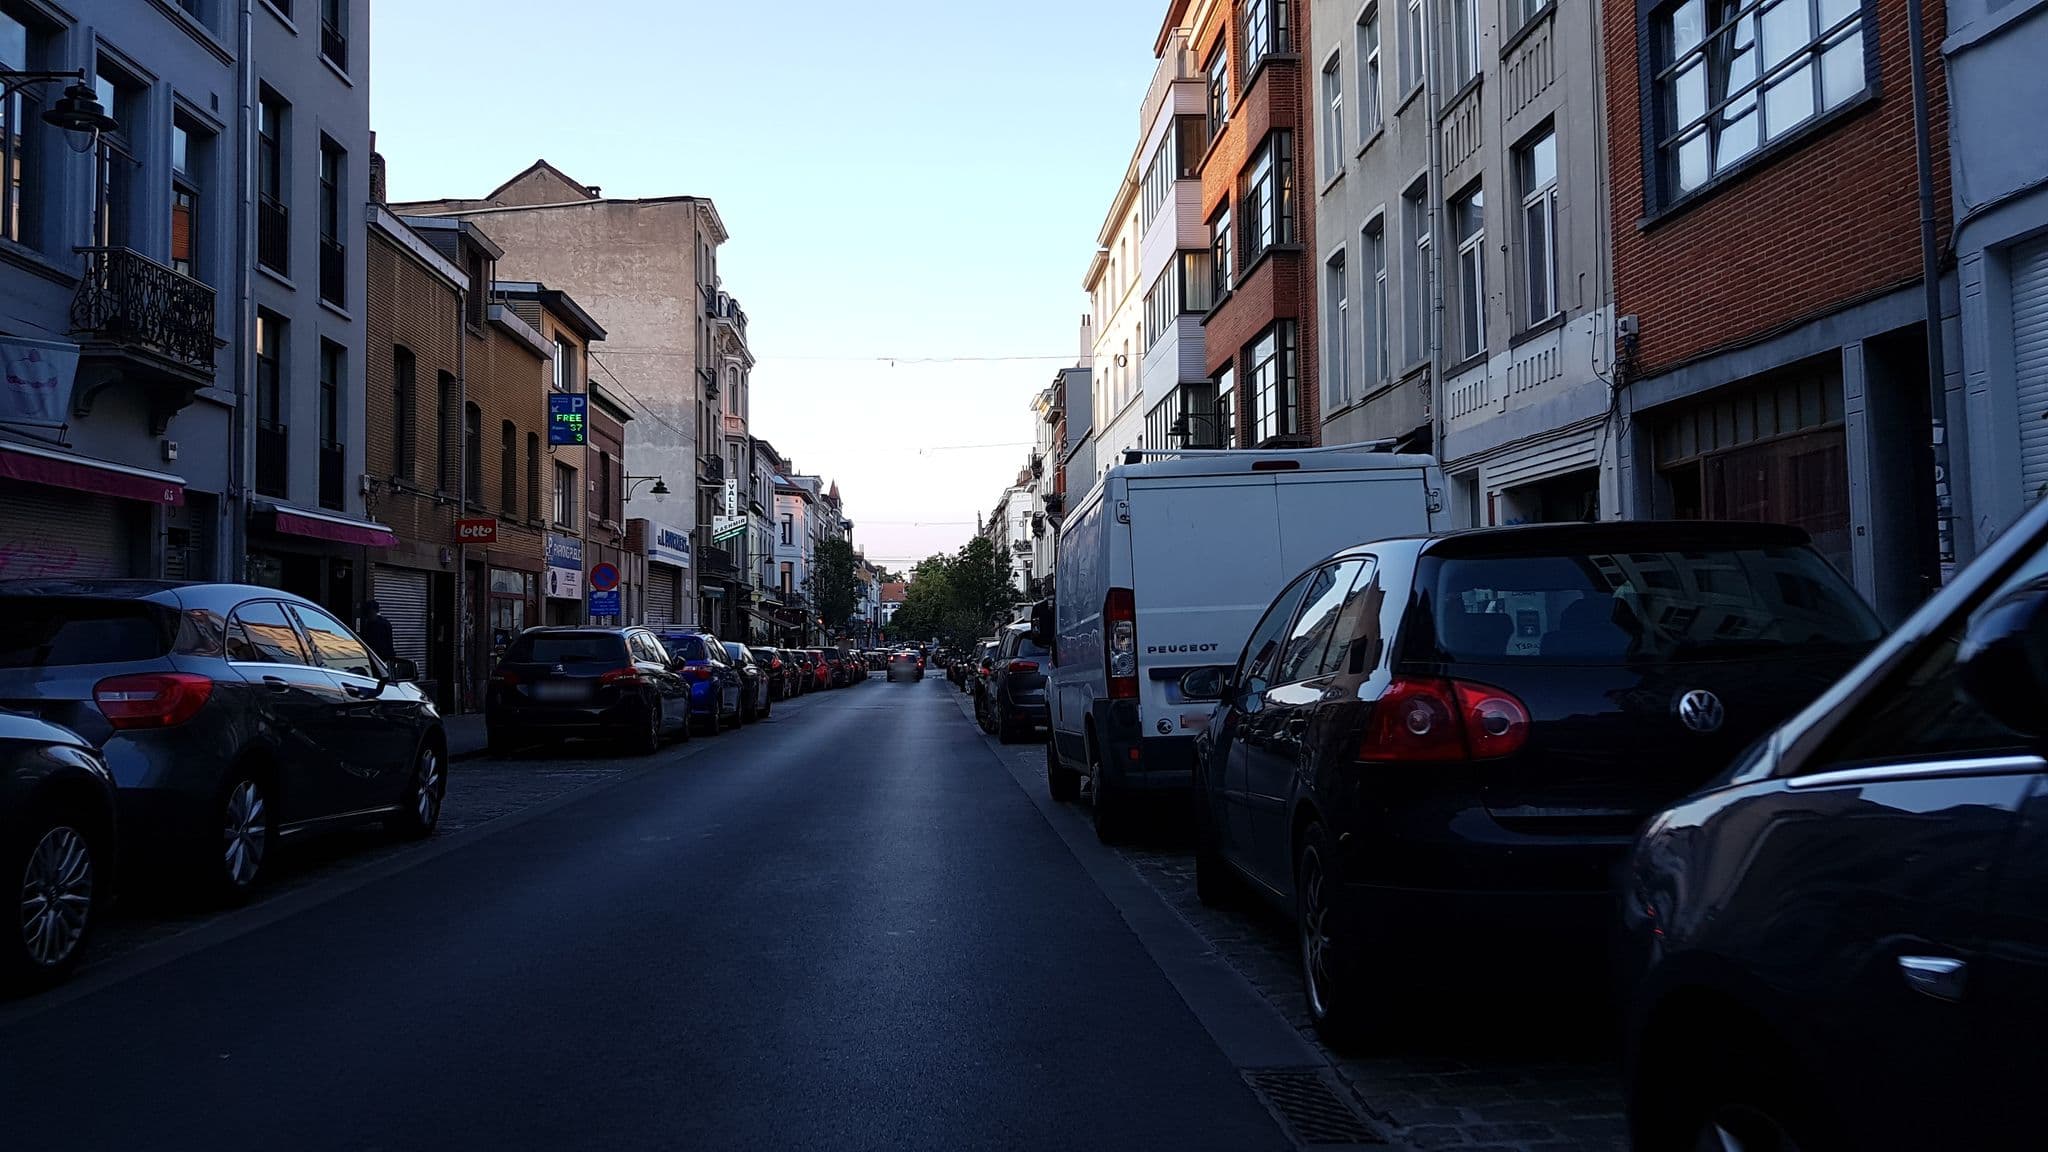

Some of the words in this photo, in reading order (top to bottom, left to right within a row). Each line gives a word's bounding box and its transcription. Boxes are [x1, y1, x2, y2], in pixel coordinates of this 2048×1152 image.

[571, 397, 585, 413] P
[556, 414, 582, 422] FREE
[569, 423, 583, 432] 37
[576, 433, 583, 442] 3
[714, 518, 745, 534] KASHMIR
[1147, 643, 1218, 654] PEUGEOT
